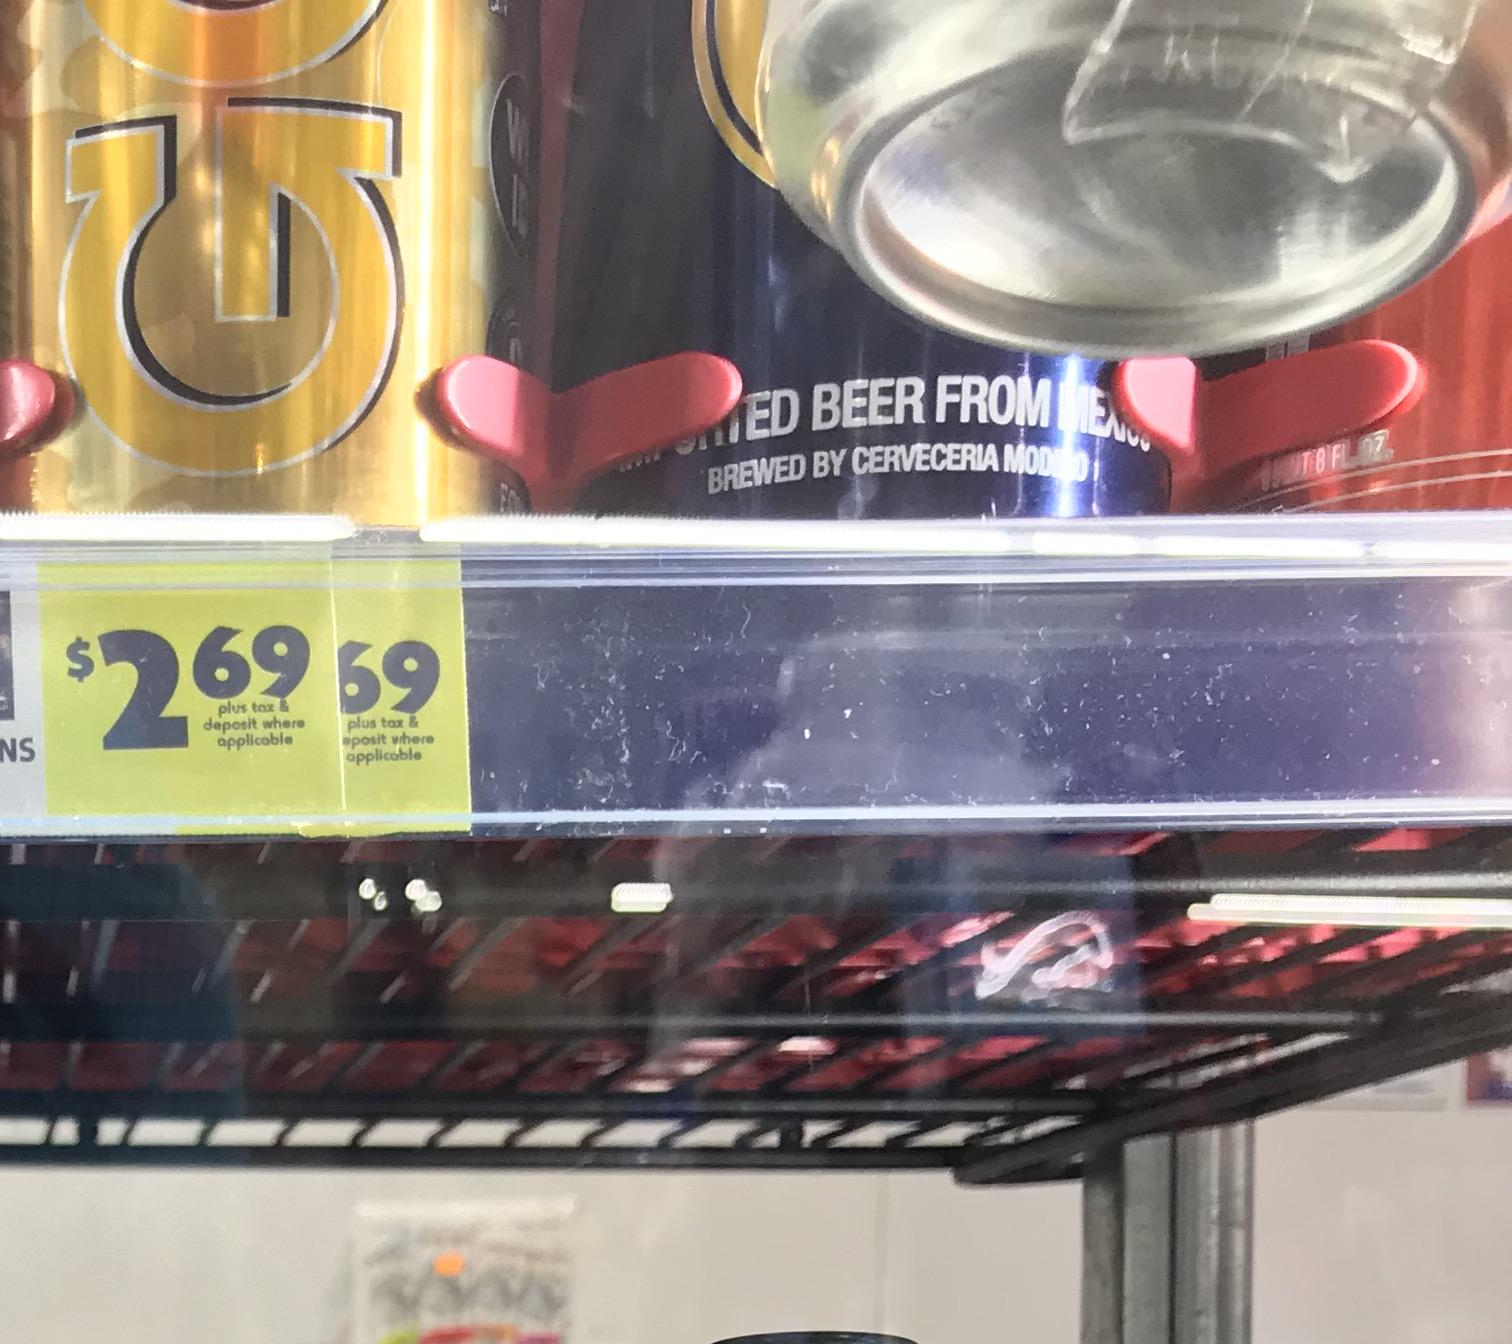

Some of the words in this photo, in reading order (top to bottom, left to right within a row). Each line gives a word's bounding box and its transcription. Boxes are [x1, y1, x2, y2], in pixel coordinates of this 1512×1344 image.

[812, 377, 925, 432] BEER
[937, 375, 1050, 428] FROM
[707, 455, 806, 494] BREWED
[814, 448, 845, 477] BY
[852, 443, 999, 475] CERVECERIA
[338, 640, 441, 714] 69
[218, 700, 249, 718] plus
[252, 701, 276, 714] tax
[204, 716, 259, 735] deposit
[262, 716, 305, 731] where
[347, 715, 378, 733] plus
[381, 716, 405, 730] tax
[217, 732, 293, 750] applicable
[391, 732, 435, 746] where
[346, 748, 423, 766] applicable
